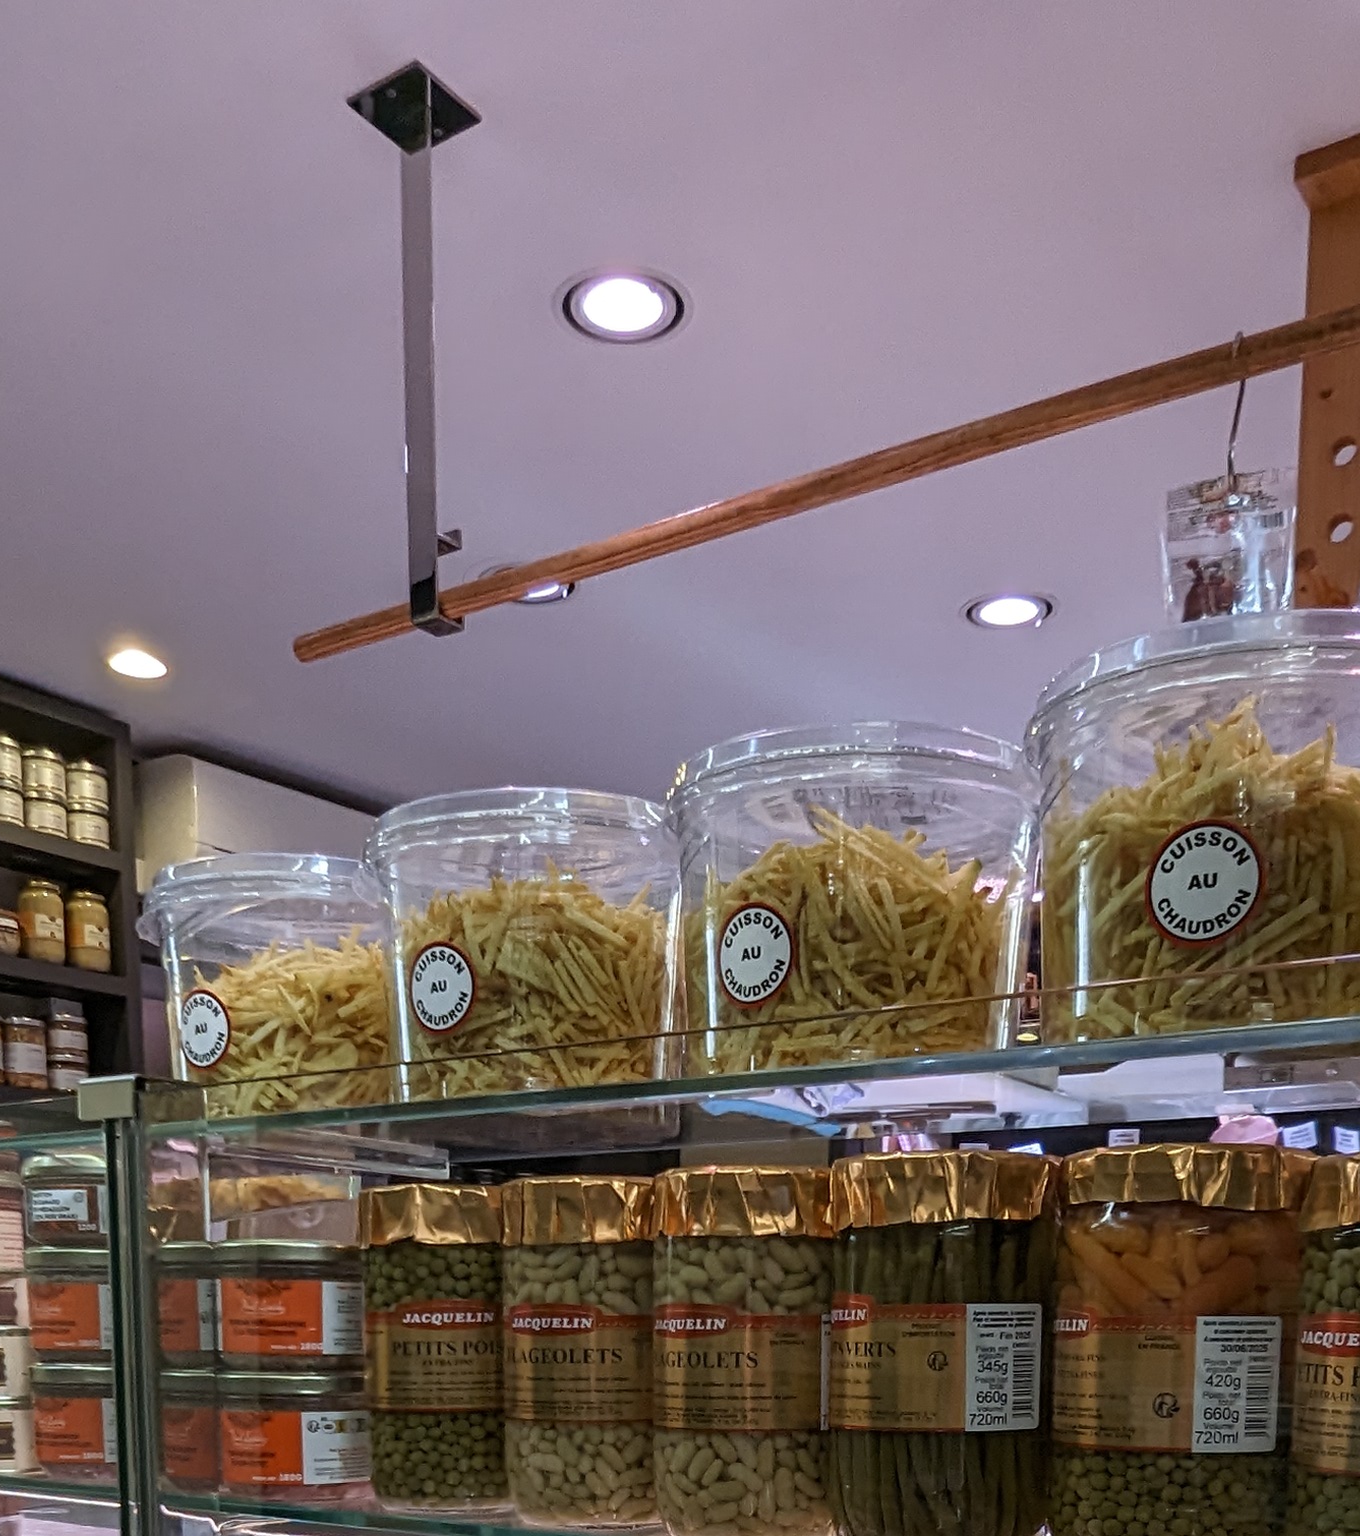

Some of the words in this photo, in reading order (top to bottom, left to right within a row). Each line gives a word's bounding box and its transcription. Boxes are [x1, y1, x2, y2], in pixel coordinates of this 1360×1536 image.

[1161, 831, 1250, 873] CUISSON
[1187, 873, 1218, 890] AU
[1158, 889, 1251, 934] CHAUDRON
[724, 912, 783, 948] CUISSON
[741, 946, 761, 961] AU
[415, 950, 465, 982] CUISSON
[725, 959, 786, 997] CHAUDRON
[431, 980, 447, 993] AU
[417, 991, 469, 1026] CHAUDRON
[403, 1312, 494, 1326] JACQUELIN
[512, 1317, 594, 1330] JACQUELIN
[393, 1340, 457, 1356] PETITS
[977, 1361, 1008, 1375] 345g
[1205, 1374, 1241, 1390] 420g
[976, 1391, 1008, 1405] 660g
[969, 1413, 1008, 1426] 720ml
[1203, 1407, 1239, 1424] 660g
[1195, 1431, 1238, 1444] 720ml
